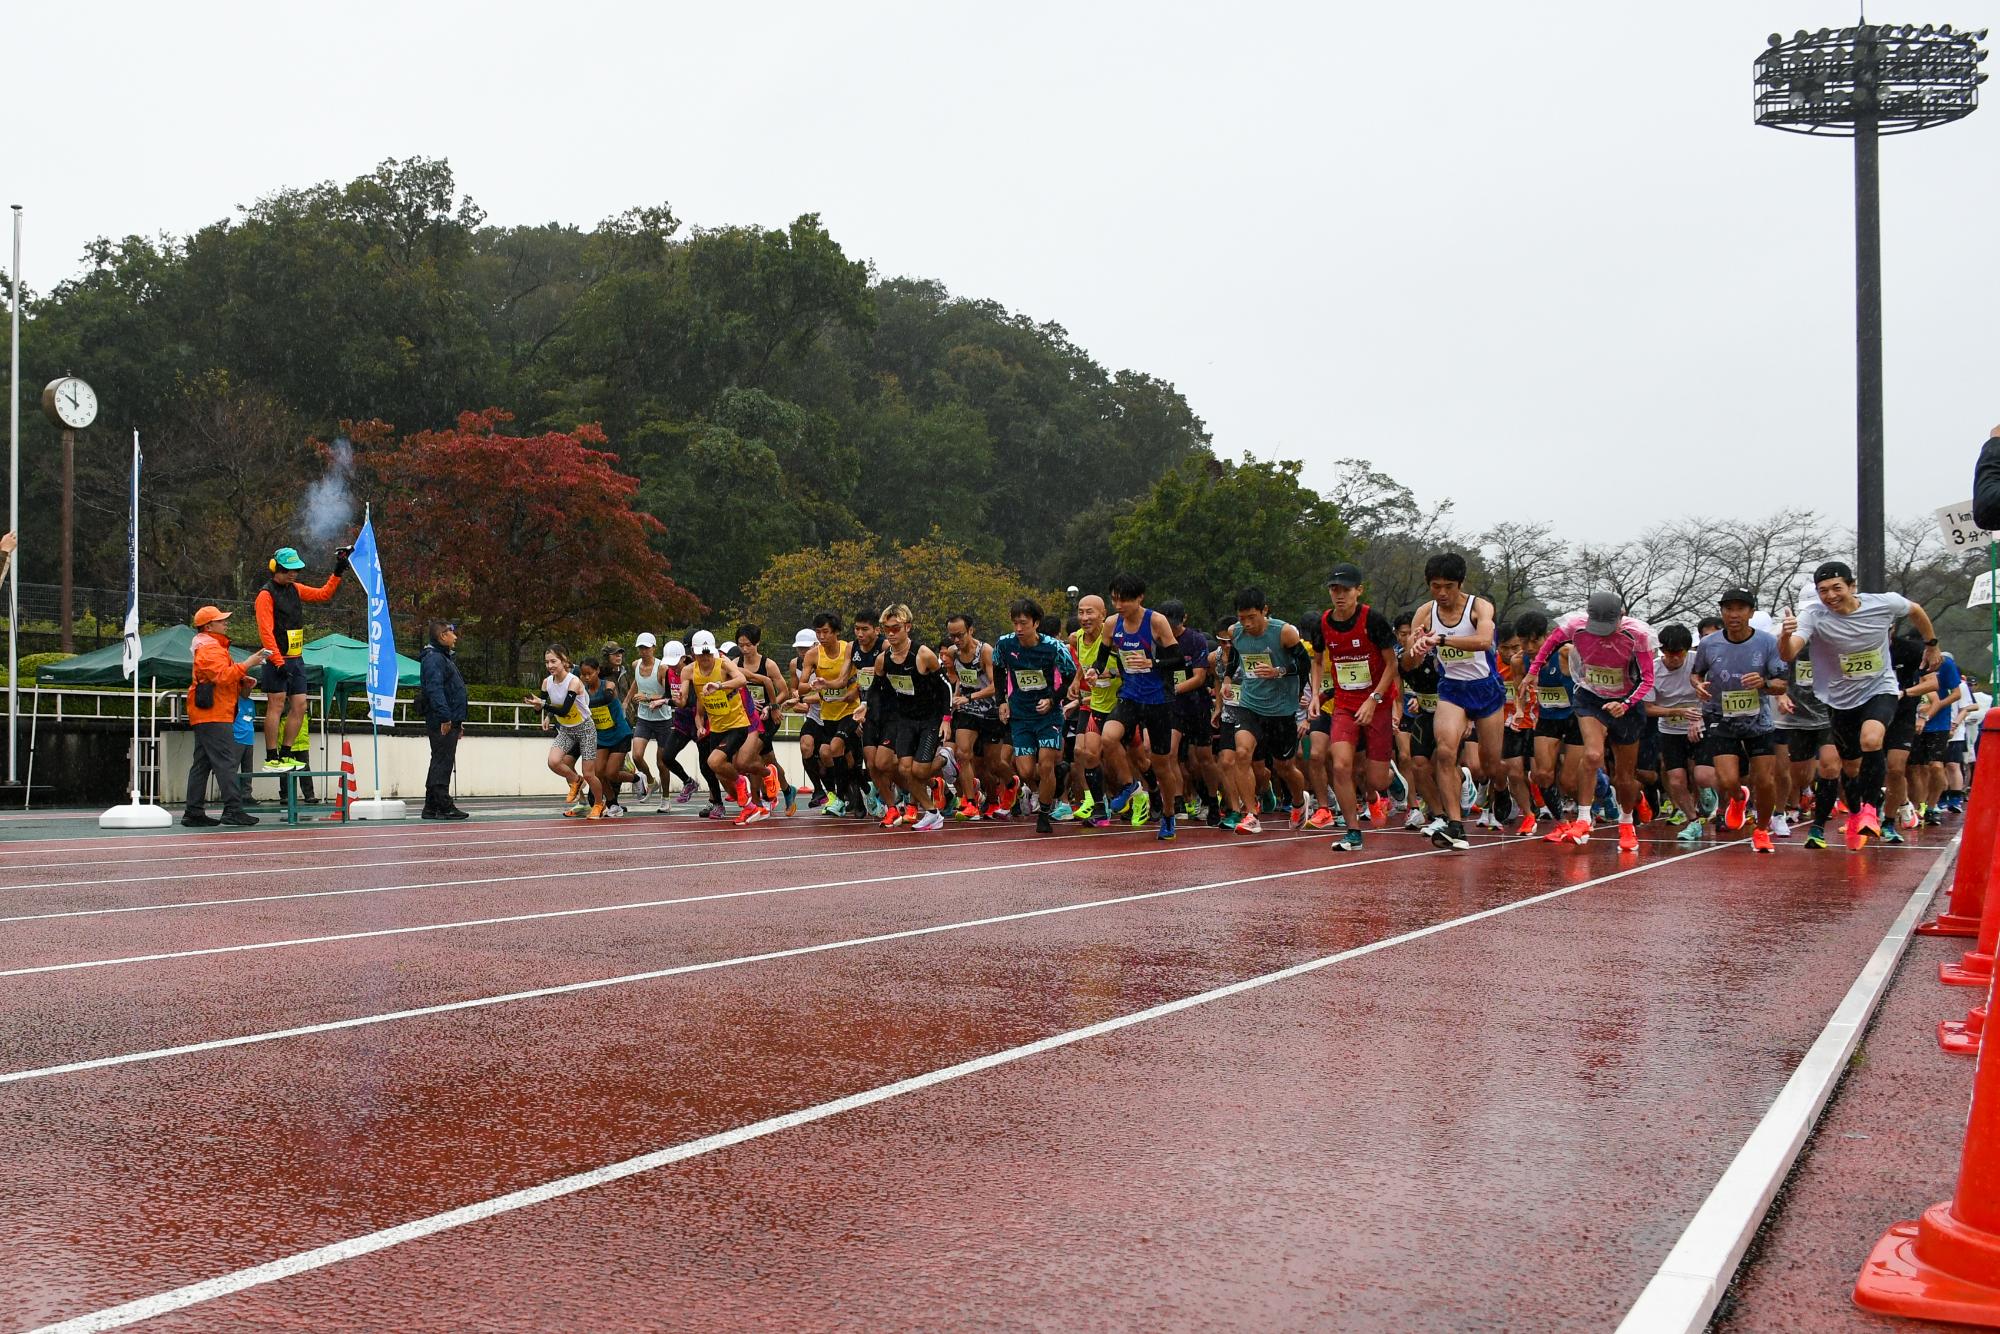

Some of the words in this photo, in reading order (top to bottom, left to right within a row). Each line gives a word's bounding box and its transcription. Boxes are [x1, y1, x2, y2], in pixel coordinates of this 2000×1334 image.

[1946, 513, 1954, 525] 1
[1441, 647, 1464, 658] 406
[1845, 660, 1873, 673] 228
[1020, 675, 1038, 685] 455
[1350, 671, 1357, 681] 5
[1588, 672, 1615, 684] 1101
[898, 680, 904, 688] 6
[824, 688, 840, 696] 203
[1540, 691, 1560, 701] 709
[1724, 698, 1753, 709] 1107
